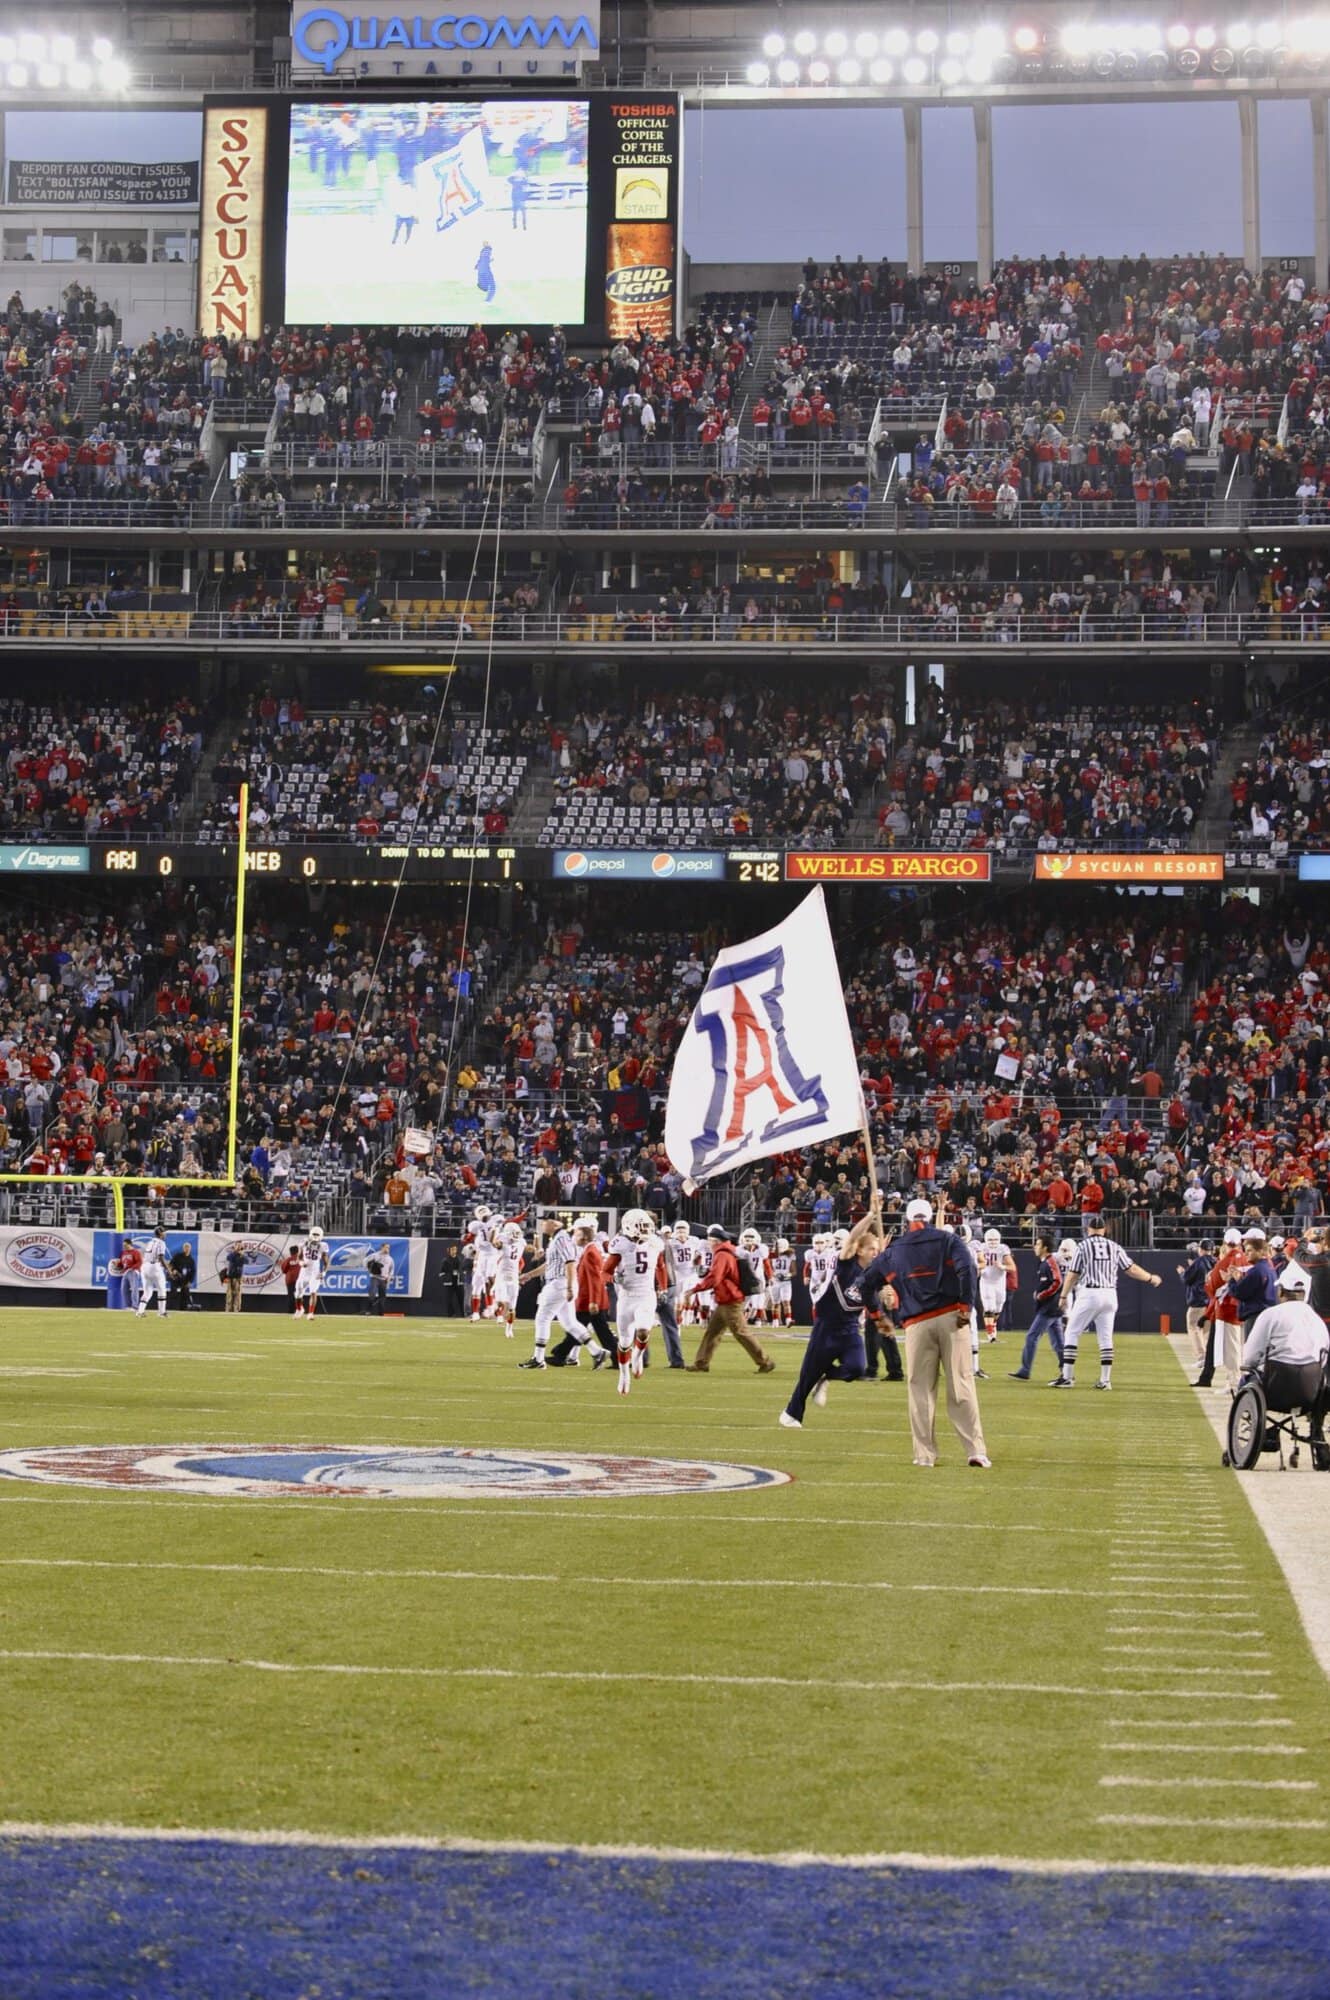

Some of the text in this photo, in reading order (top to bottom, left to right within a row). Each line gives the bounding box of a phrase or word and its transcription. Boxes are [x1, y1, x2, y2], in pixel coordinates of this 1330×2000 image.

[294, 9, 598, 75] QUALCOMM
[360, 61, 577, 74] STADIUM
[610, 104, 676, 116] TOSHIBA
[617, 119, 669, 128] OFFICIAL
[621, 131, 664, 140] COPIER
[621, 143, 664, 152] OF THE
[612, 155, 673, 164] CHARGERS
[21, 164, 186, 176] REPORT FAN CONDUCT ISSUES,
[16, 176, 43, 187] TEXT
[160, 177, 191, 187] YOUR
[17, 190, 188, 200] LOCATION AND ISSUE TO 41513
[623, 204, 659, 214] START
[211, 119, 250, 335] SYCUAN
[944, 264, 960, 275] 20
[1281, 260, 1297, 270] 19
[617, 268, 668, 283] BUD
[609, 279, 673, 296] LIGHT
[381, 848, 409, 858] DOWN
[417, 848, 445, 858] TO GO
[452, 848, 489, 858] BALL ON
[27, 852, 80, 868] Degree
[106, 851, 172, 875] ARI 0
[244, 852, 316, 876] NEB 0
[589, 858, 625, 871] pepsi
[676, 859, 712, 871] pepsi
[796, 858, 978, 876] WELLS FARGO
[1079, 861, 1217, 873] SYCUAN RESORT
[16, 1236, 66, 1251] PACIFIC LIFE
[305, 1246, 318, 1260] 26
[676, 1248, 691, 1263] 35
[1094, 1241, 1108, 1260] H
[10, 1259, 69, 1278] HOLIDAY BOWL
[635, 1251, 648, 1274] 5
[775, 1259, 787, 1270] 31
[814, 1259, 826, 1271] 16
